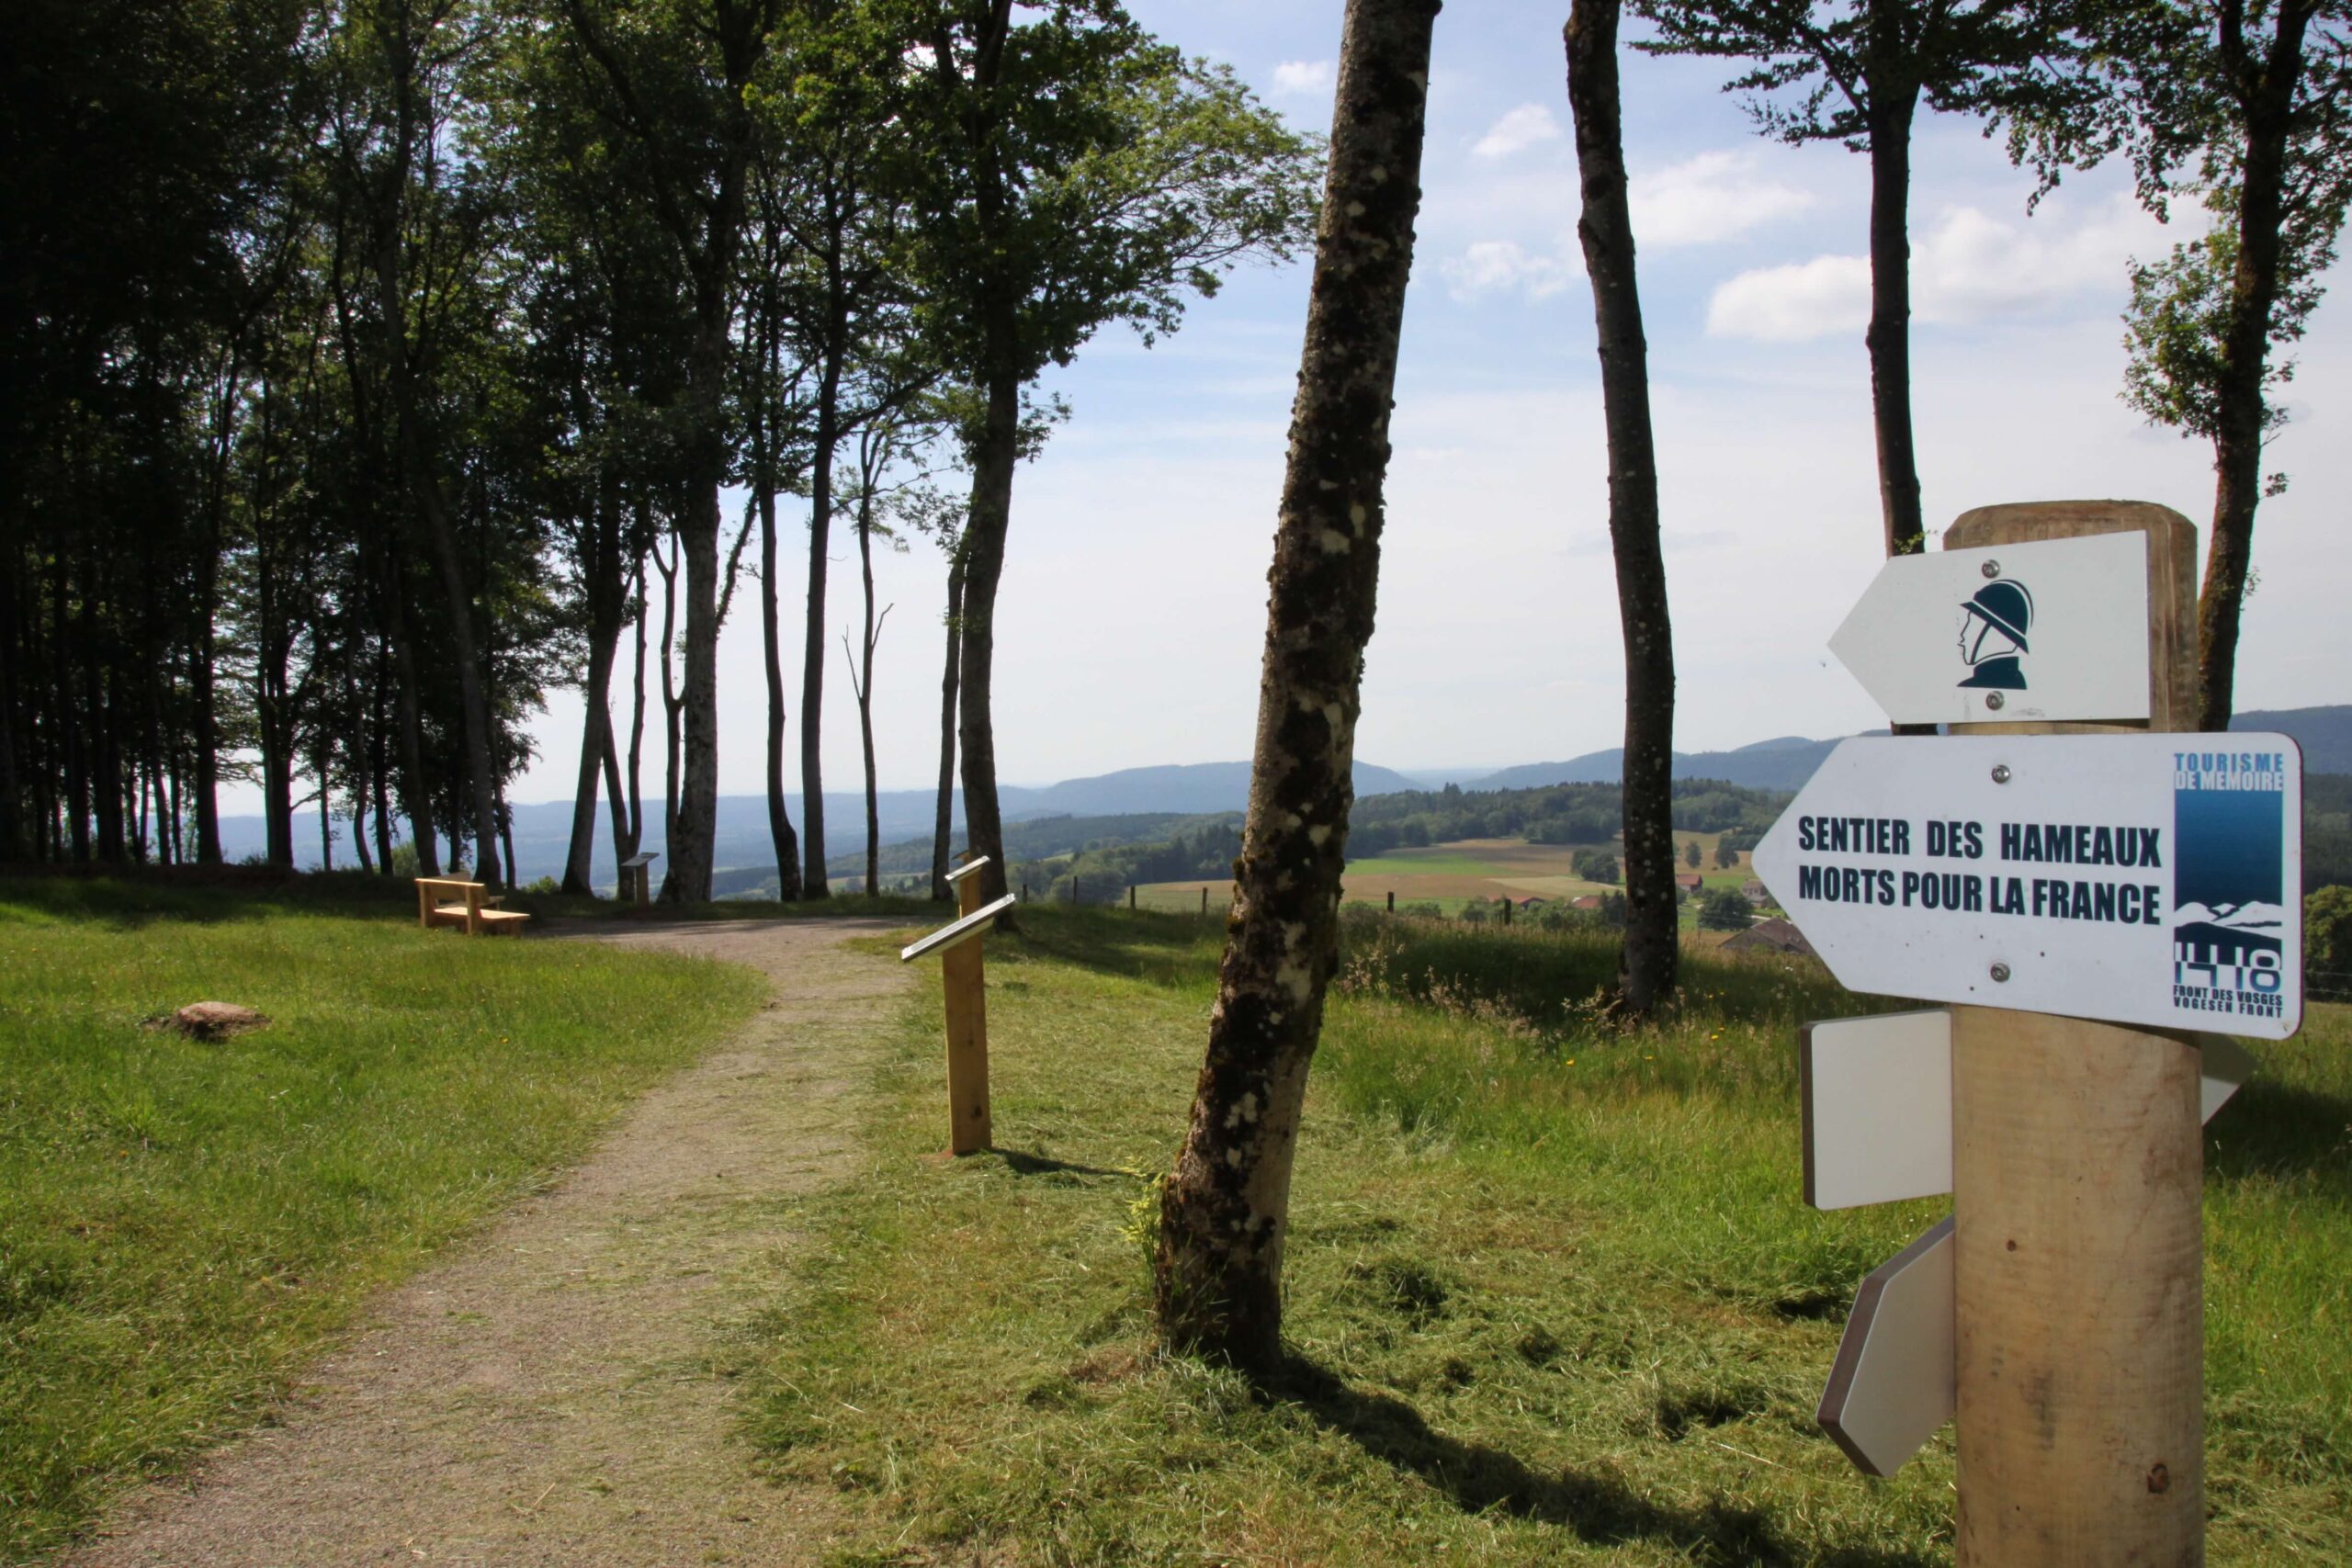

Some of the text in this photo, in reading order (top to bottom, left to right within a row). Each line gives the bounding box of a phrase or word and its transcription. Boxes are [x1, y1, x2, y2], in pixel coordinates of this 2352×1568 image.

[2174, 752, 2283, 772] TOURISME
[2175, 771, 2197, 790] DE
[1798, 816, 2162, 868] SENTIER DES HAMEAUX
[1798, 865, 2161, 926] MORTS POUR LA FRANCE
[2174, 985, 2283, 1007] FRONT DES VOSGES
[2174, 997, 2283, 1019] VOGESEN FRONT
